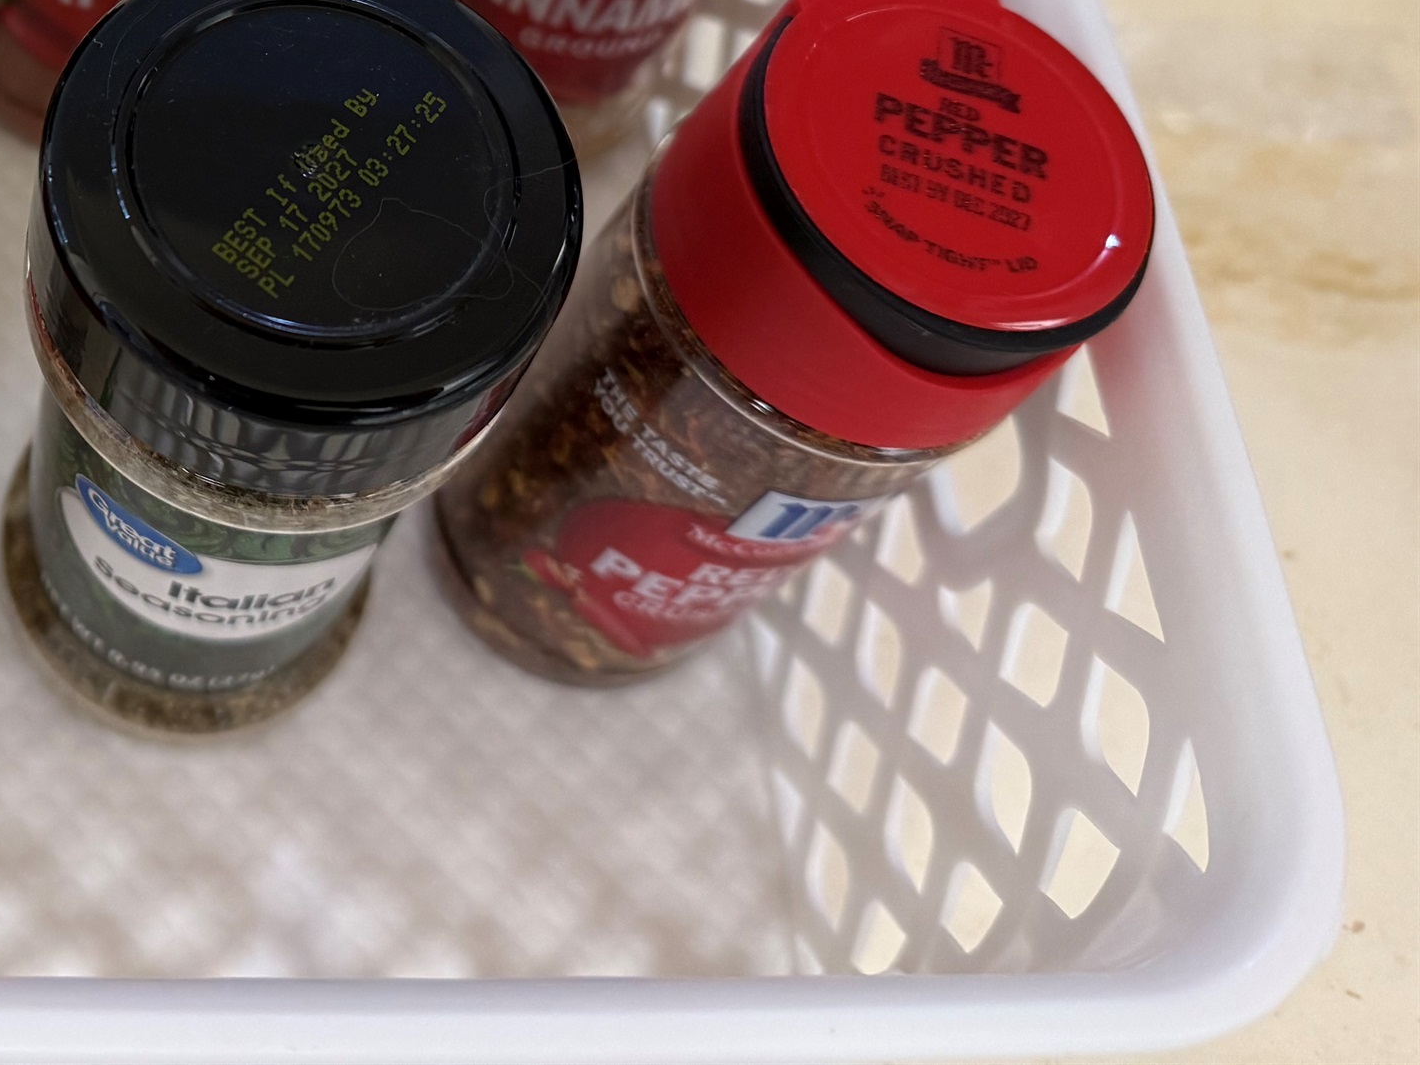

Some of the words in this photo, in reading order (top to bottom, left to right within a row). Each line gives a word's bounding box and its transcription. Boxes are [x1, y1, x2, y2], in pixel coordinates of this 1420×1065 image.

[874, 92, 1048, 180] PEPPER
[879, 134, 1032, 203] CRUSHED
[212, 207, 267, 264] BEST
[266, 174, 297, 207] If
[344, 88, 378, 118] By
[258, 270, 296, 298] PL
[291, 188, 363, 262] 170973
[358, 91, 448, 187] 03:27:25
[881, 164, 921, 193] BEST
[927, 179, 949, 202] BY
[236, 236, 277, 280] SEP
[279, 203, 309, 232] 17
[307, 148, 359, 203] 2027
[866, 200, 920, 242] SNAP
[1005, 256, 1039, 274] LID
[594, 378, 630, 433] YOU
[602, 367, 639, 422] THE
[642, 423, 721, 489] TASTE
[88, 487, 176, 560] Great
[104, 511, 173, 567] Value
[94, 555, 327, 625] Seasoning
[167, 576, 336, 611] Italian
